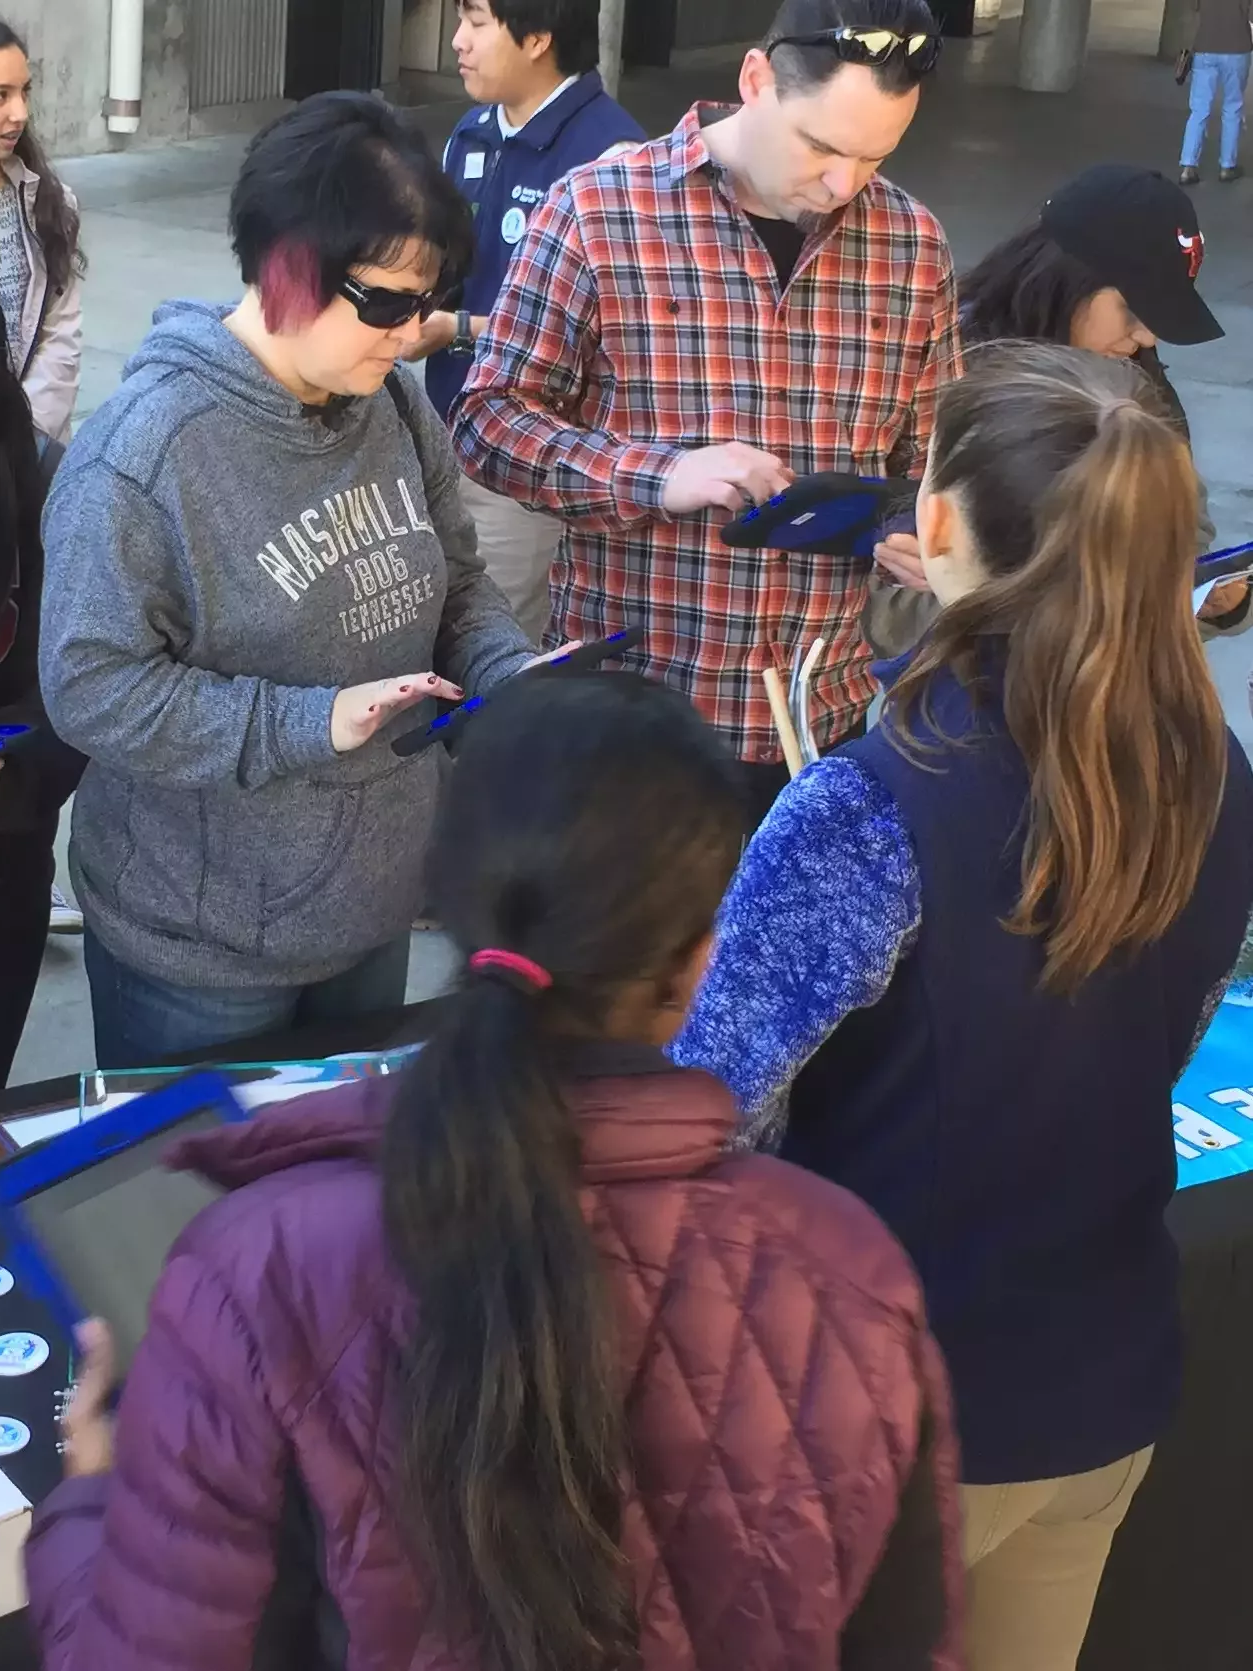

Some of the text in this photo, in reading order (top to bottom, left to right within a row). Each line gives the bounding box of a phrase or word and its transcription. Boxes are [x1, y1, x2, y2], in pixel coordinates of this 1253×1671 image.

[257, 478, 436, 601] NASHVILL
[345, 543, 409, 600] 1806
[339, 573, 435, 636] TENNESSEE
[361, 606, 419, 643] AUTHENTIC
